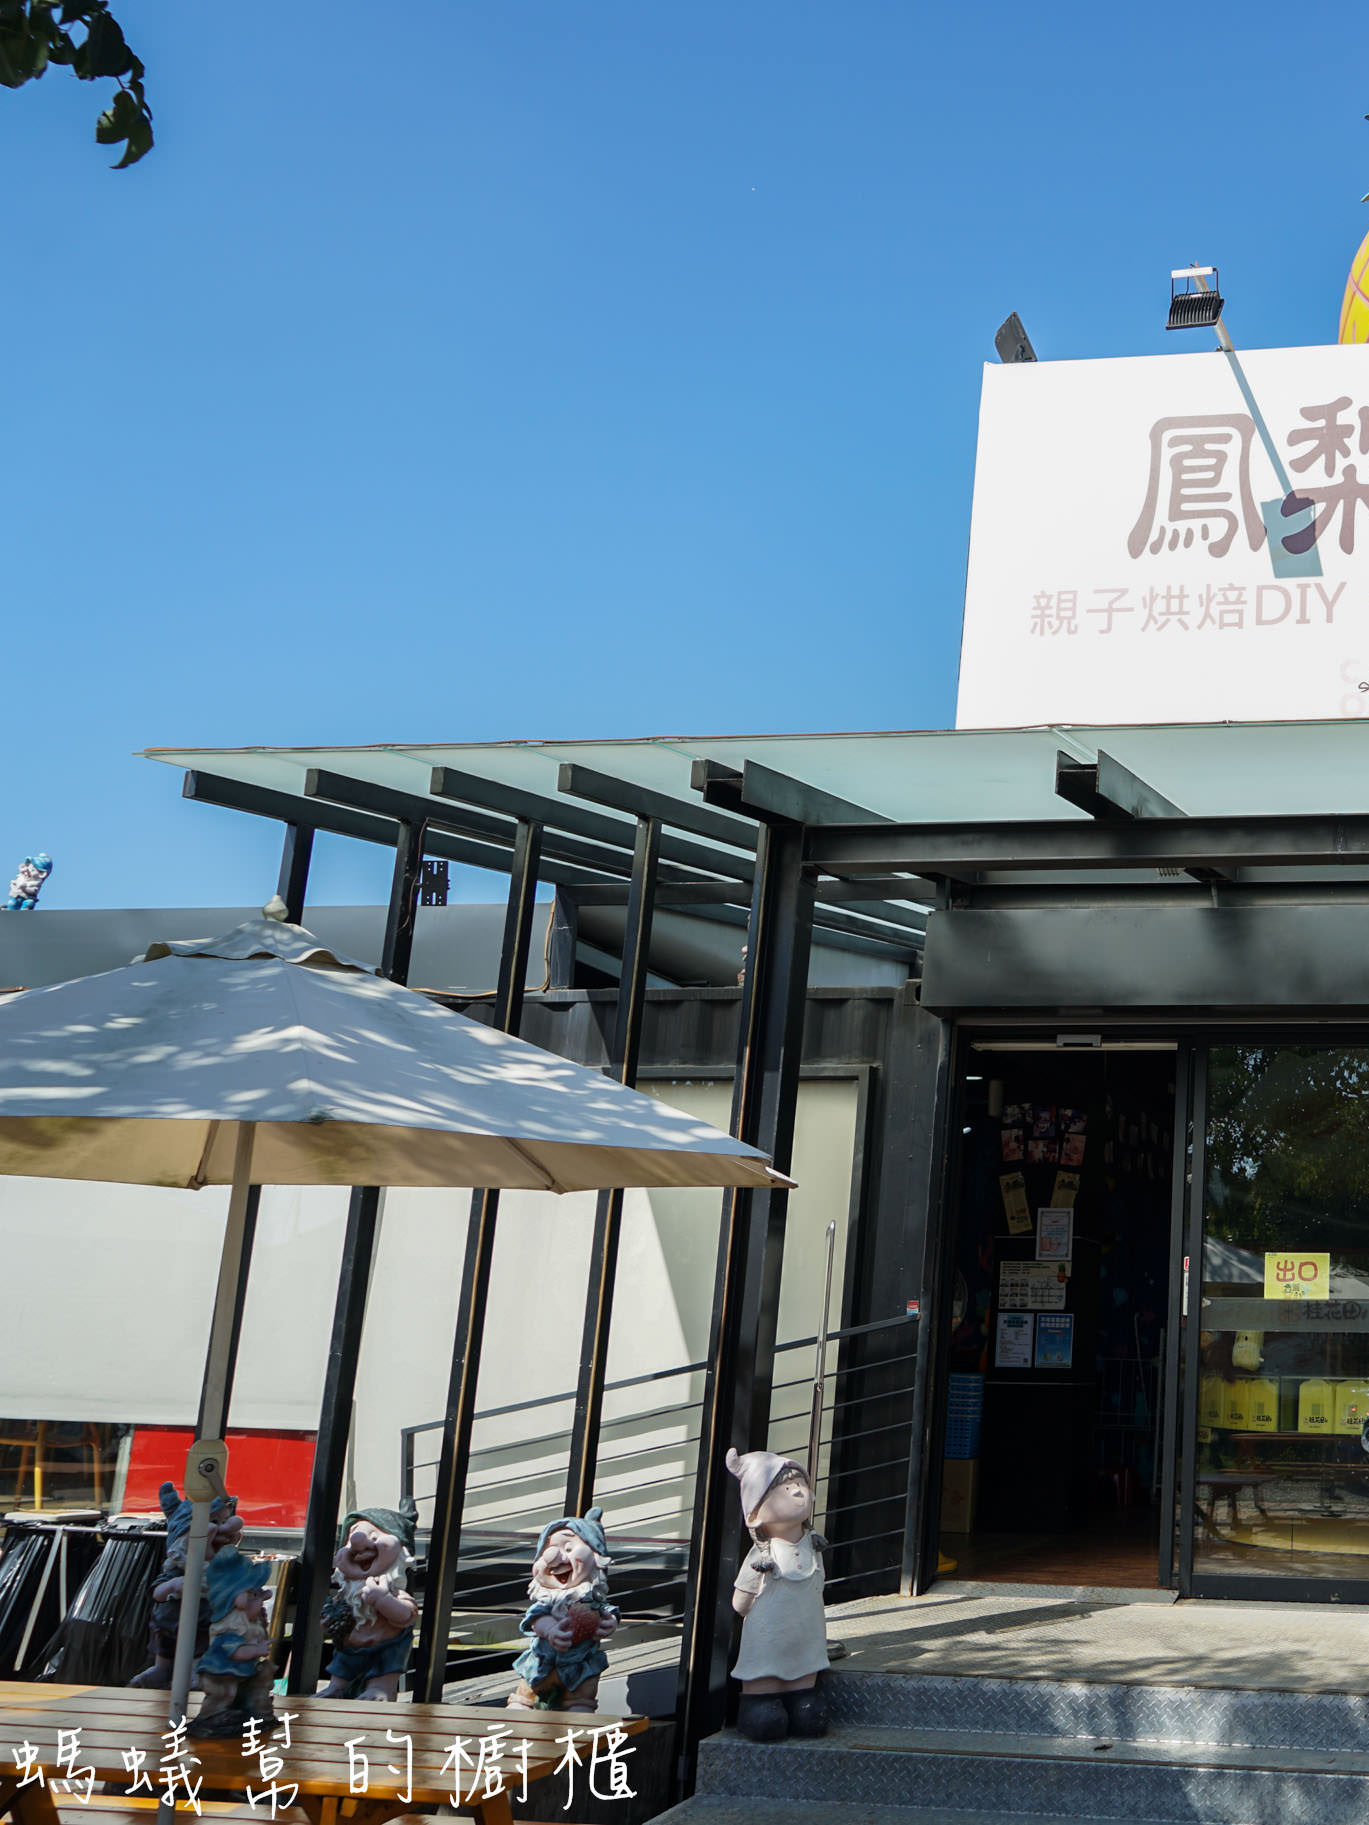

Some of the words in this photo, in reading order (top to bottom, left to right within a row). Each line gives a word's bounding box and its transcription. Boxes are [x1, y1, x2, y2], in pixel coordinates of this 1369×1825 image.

[1029, 580, 1348, 637] 親子烘焙DIY
[1275, 1259, 1319, 1282] 出口
[1304, 1301, 1362, 1321] 桂花田
